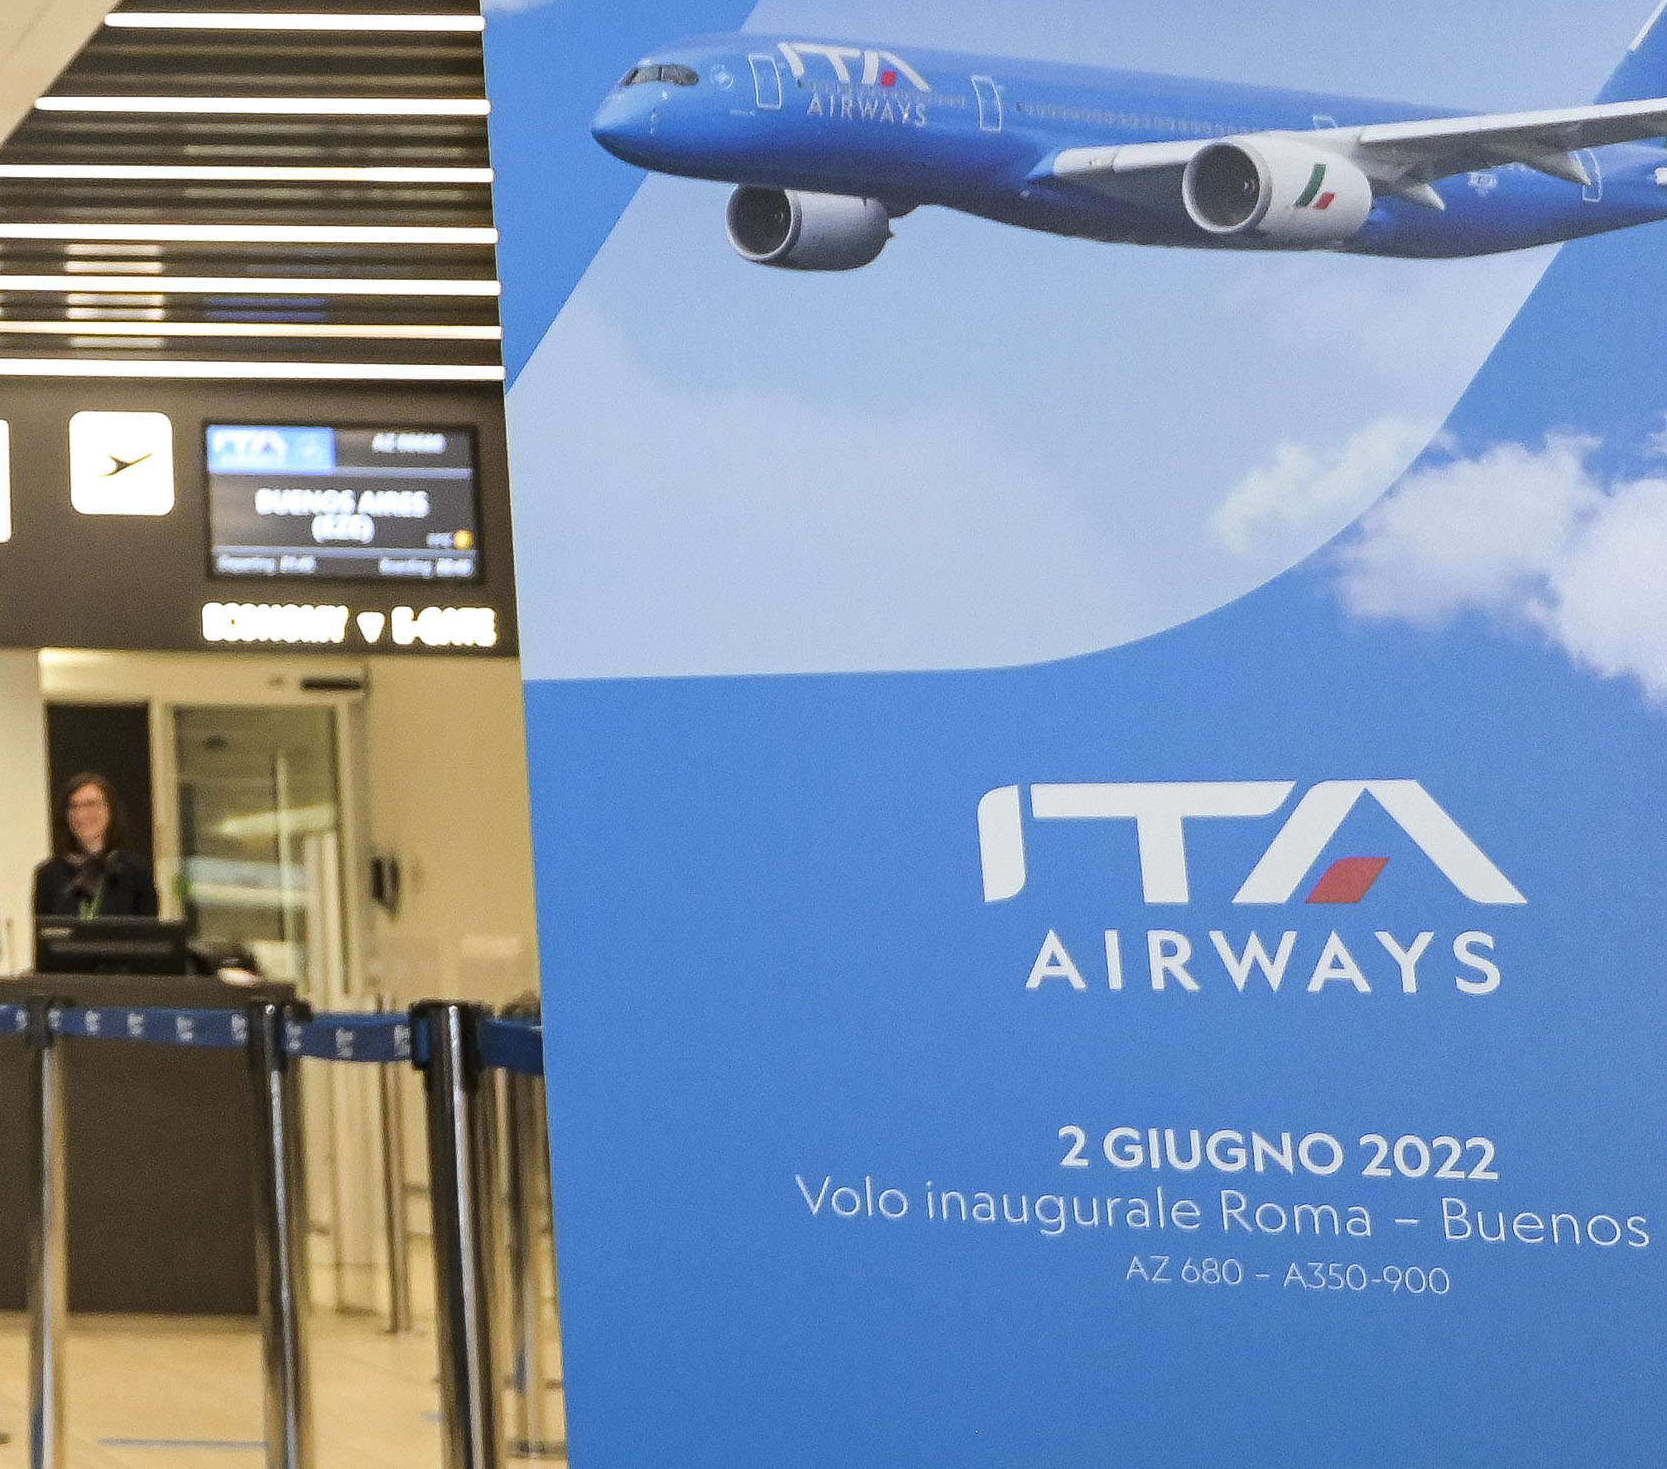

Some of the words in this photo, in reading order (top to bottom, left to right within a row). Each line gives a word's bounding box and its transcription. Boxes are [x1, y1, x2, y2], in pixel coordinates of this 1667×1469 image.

[777, 41, 931, 92] ITA
[806, 91, 927, 129] AIRWAYS
[357, 489, 430, 518] AIRES
[977, 779, 1529, 905] ITA
[1025, 929, 1502, 995] AIRWAYS
[1058, 1124, 1092, 1168] 2
[1103, 1126, 1345, 1176] GIUGNO
[1359, 1132, 1499, 1181] 2022
[795, 1173, 910, 1220] Volo
[925, 1179, 1202, 1236] inaugurale
[1220, 1189, 1372, 1238] Roma
[1440, 1196, 1651, 1249] Buenos
[1125, 1254, 1172, 1284] AZ
[1180, 1256, 1243, 1286] 680
[1283, 1261, 1452, 1296] A350-900
